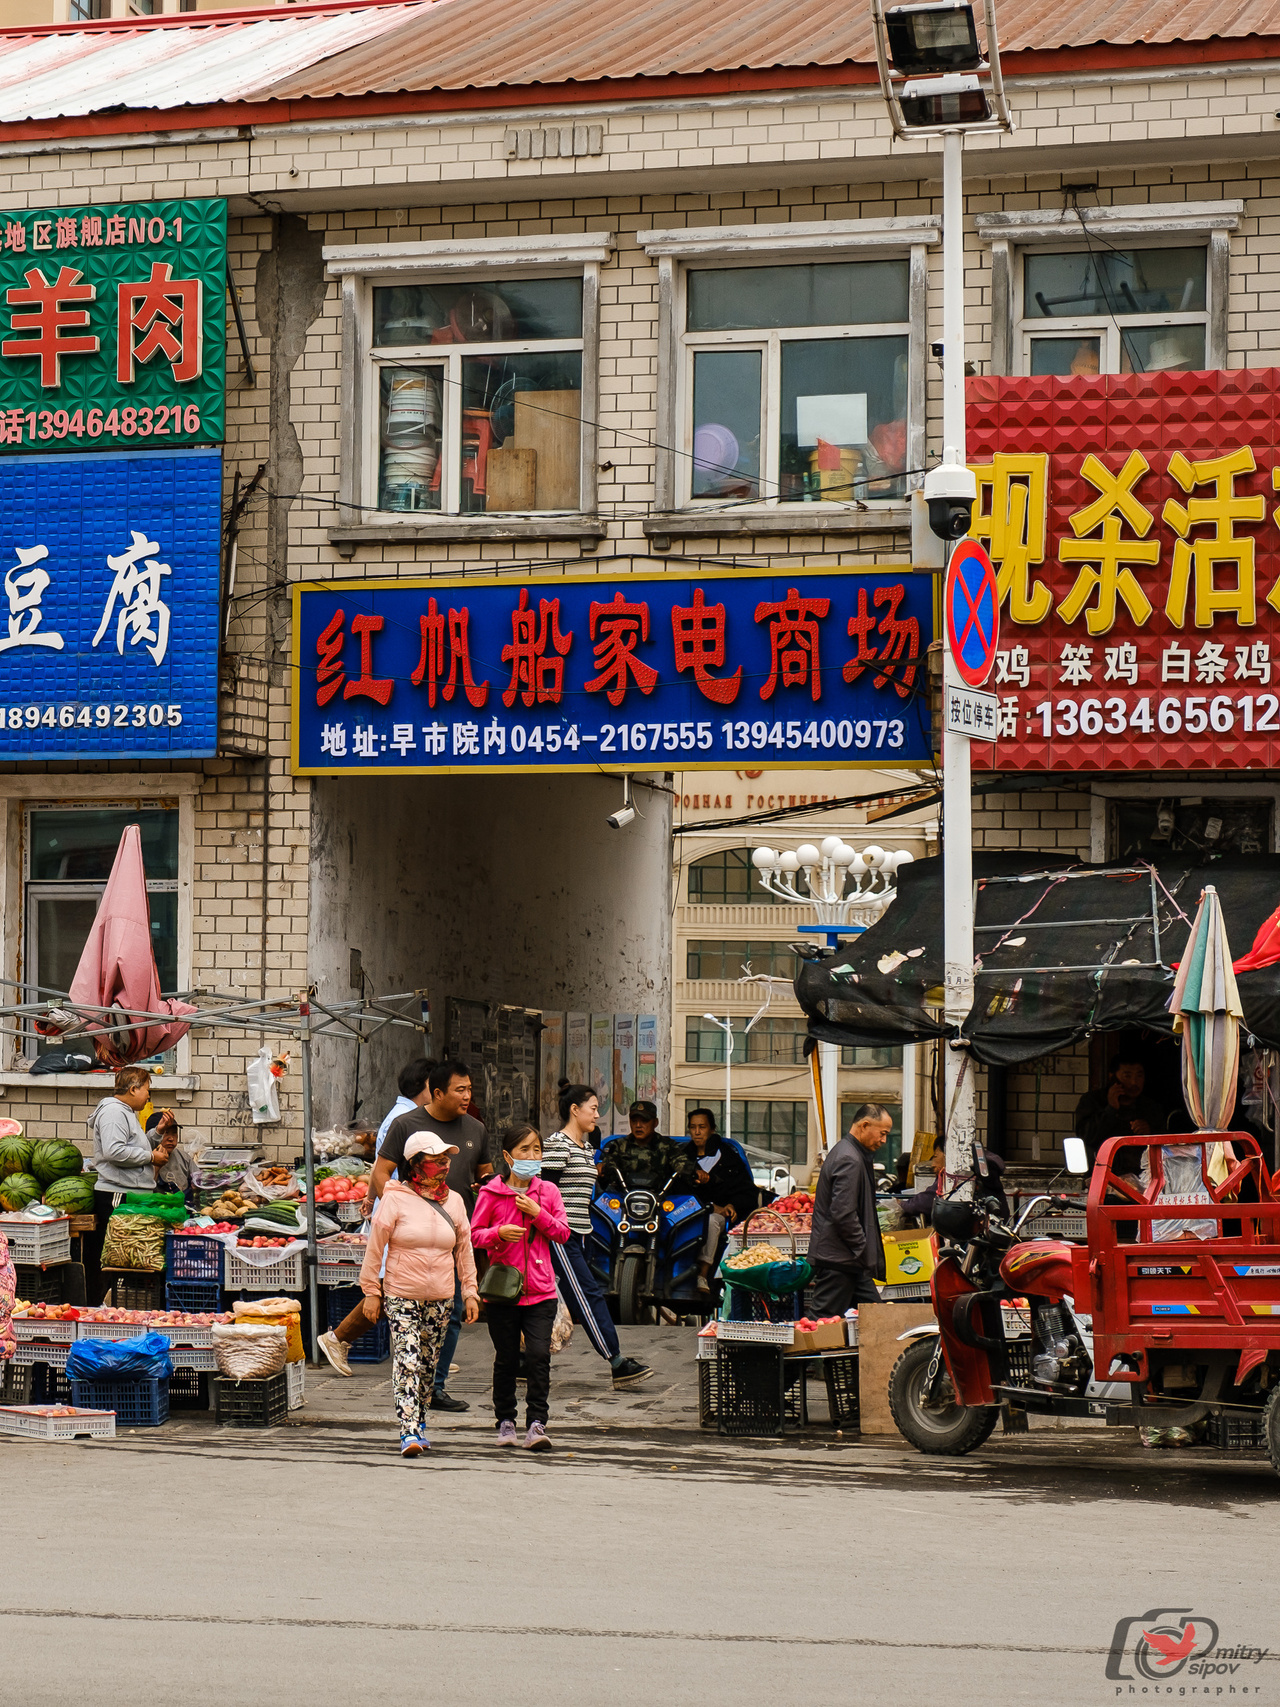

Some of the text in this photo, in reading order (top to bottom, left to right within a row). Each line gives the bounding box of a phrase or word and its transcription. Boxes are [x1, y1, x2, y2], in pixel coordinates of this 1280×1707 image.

[965, 445, 1280, 636] 现杀活
[316, 583, 920, 708] 红帆船家电商场
[986, 640, 1271, 688] 鸡 笨鸡 白条鸡
[721, 719, 905, 750] 13945400973
[951, 695, 993, 731] 按位停车
